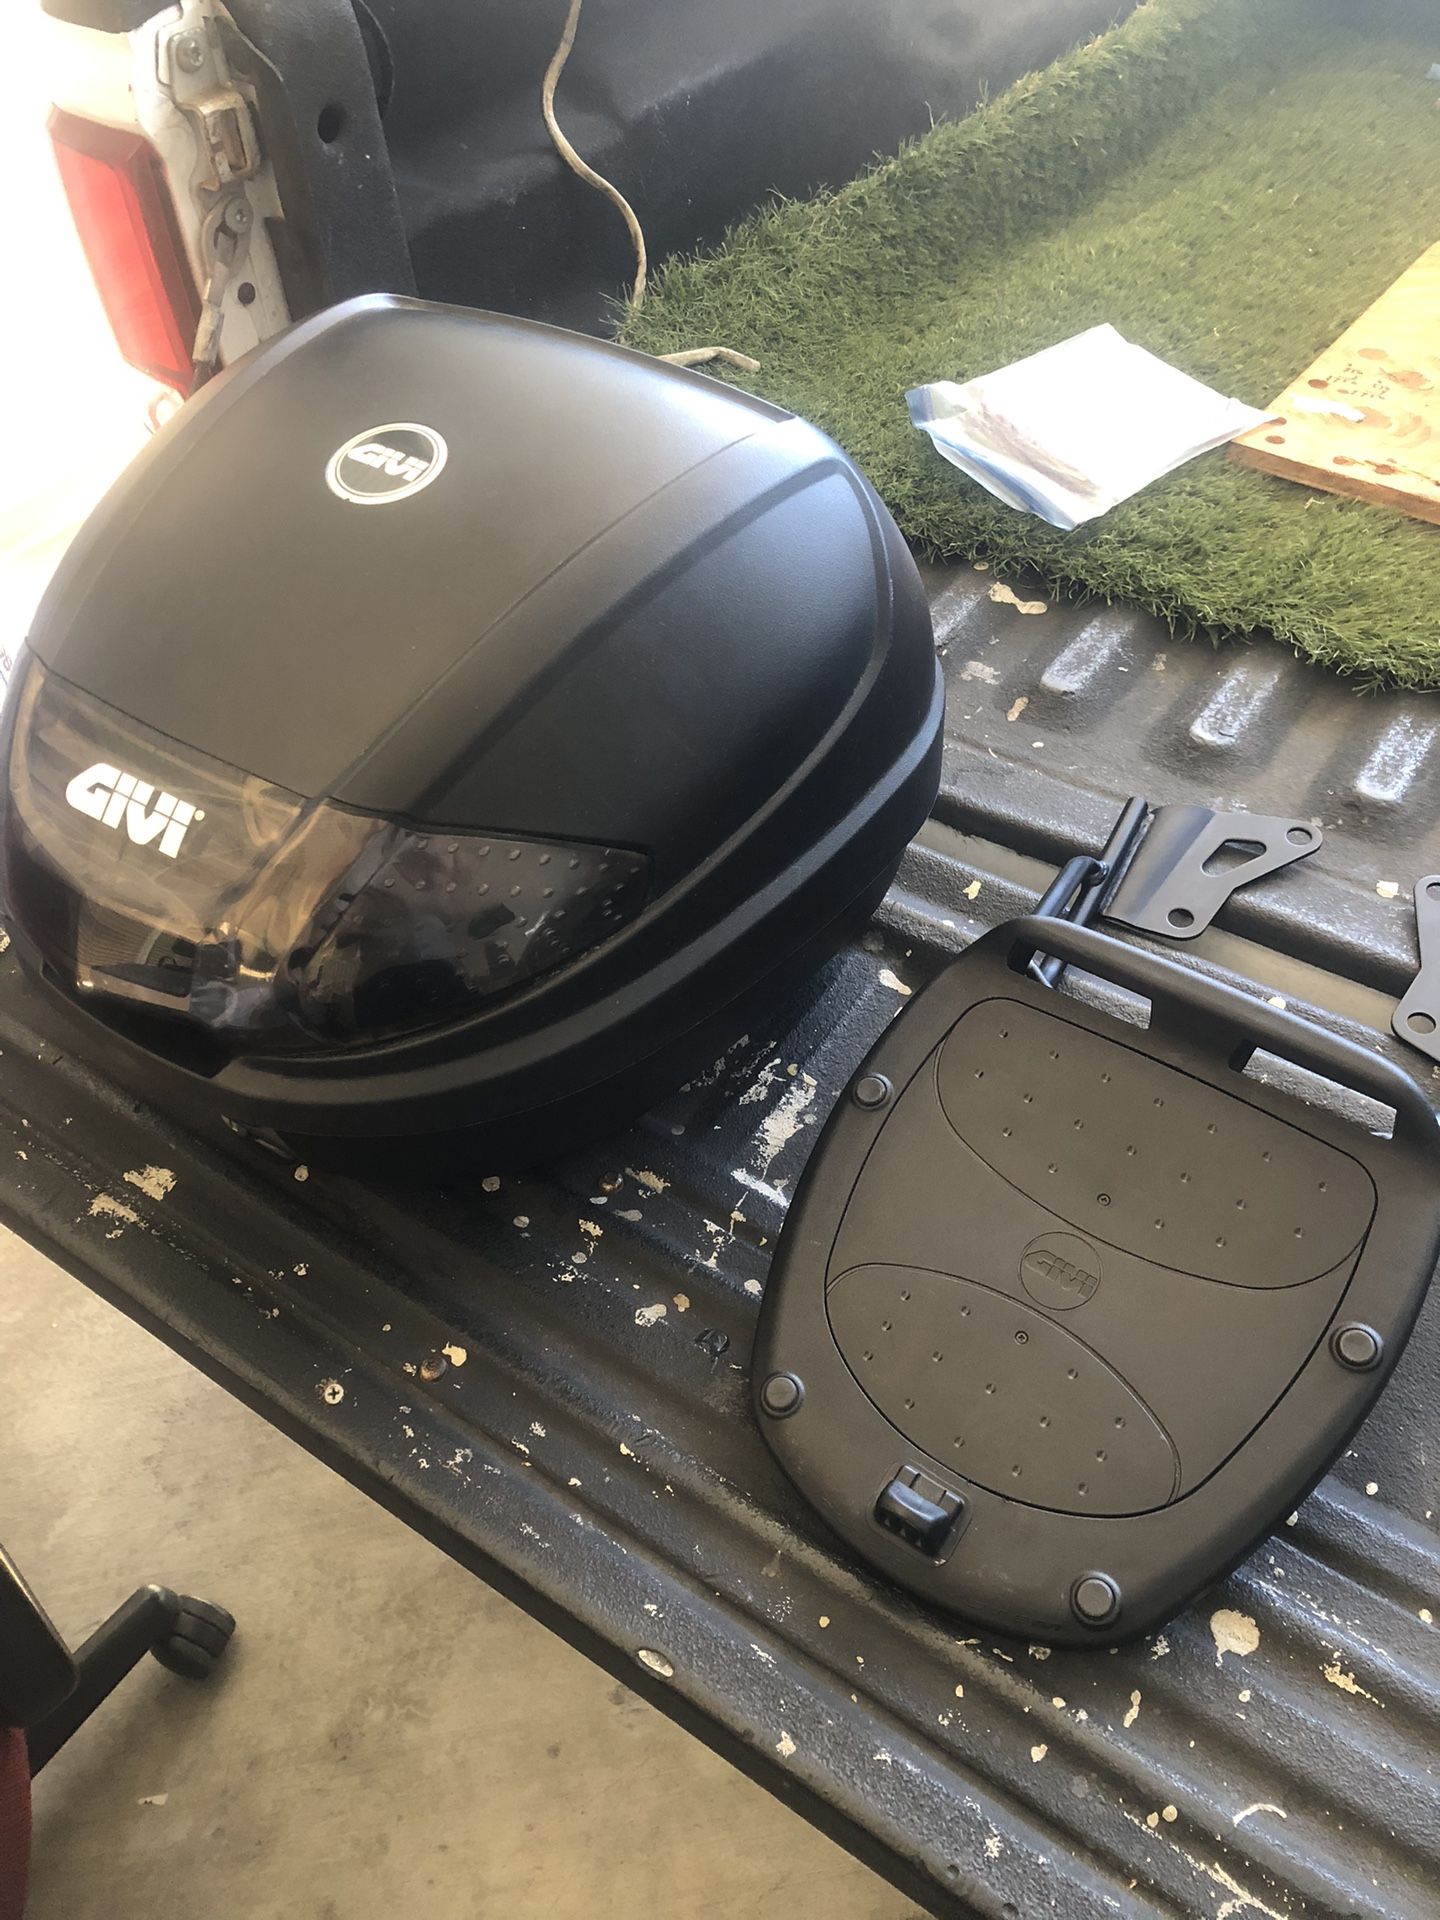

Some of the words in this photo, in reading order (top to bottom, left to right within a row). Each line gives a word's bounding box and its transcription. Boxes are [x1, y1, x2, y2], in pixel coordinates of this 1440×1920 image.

[347, 442, 430, 482] GIVI
[65, 762, 199, 859] GIVI
[1024, 1249, 1098, 1299] GIVI
